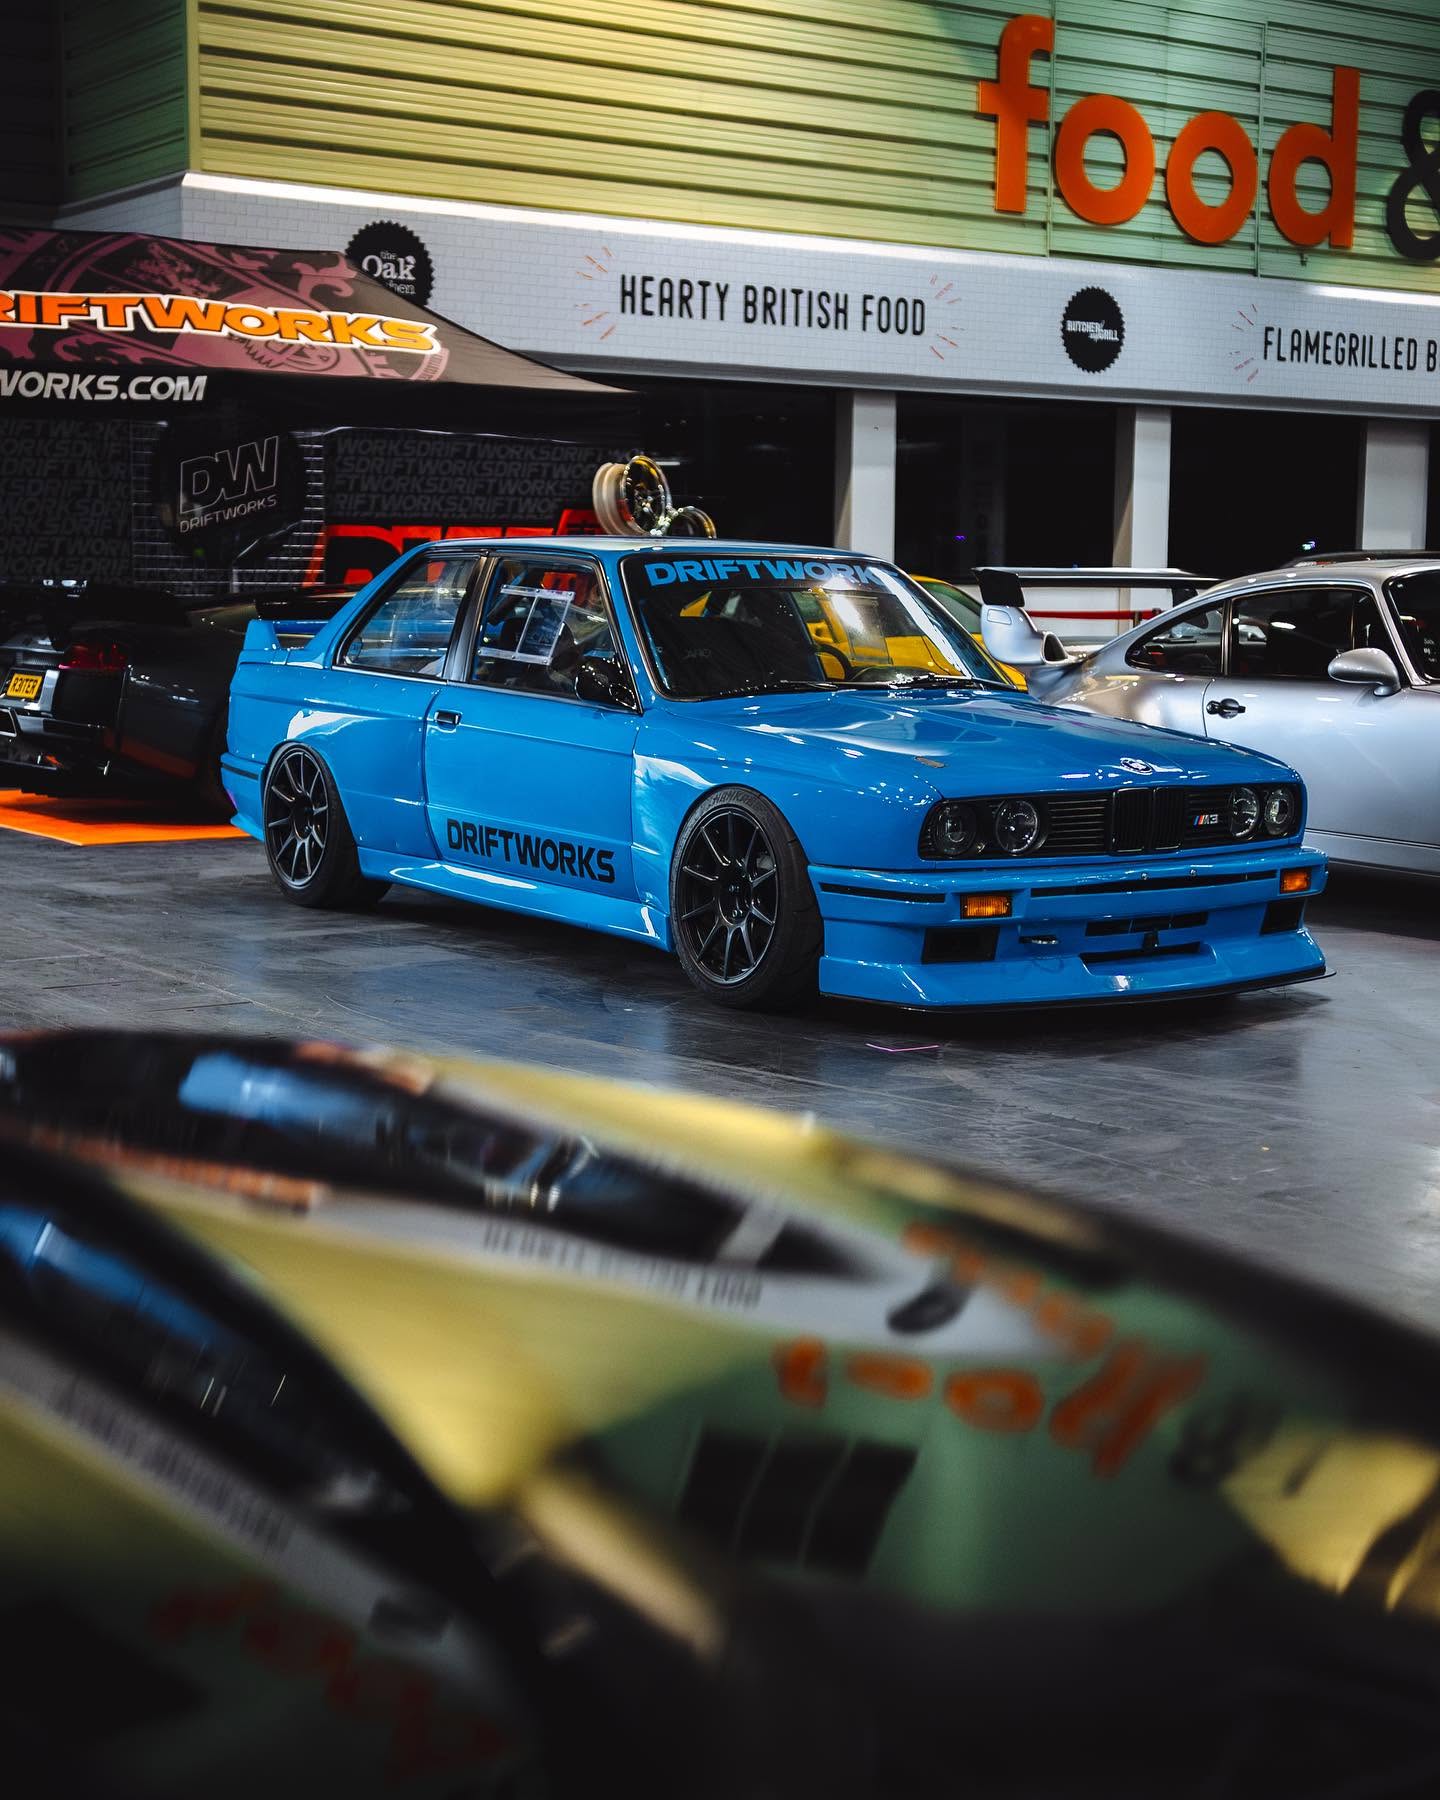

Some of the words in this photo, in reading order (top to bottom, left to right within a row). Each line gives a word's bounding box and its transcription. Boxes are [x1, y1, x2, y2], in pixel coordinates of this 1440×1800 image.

[978, 14, 1360, 248] food
[361, 254, 416, 280] Oak
[620, 273, 730, 321] HEARTY
[743, 285, 848, 331] BRITISH
[862, 294, 926, 336] FOOD
[1263, 326, 1418, 371] FLAMEGRILLED
[180, 435, 279, 514] DW
[179, 494, 278, 534] DRIFTWORKS
[446, 817, 616, 885] DRIFTWORKS
